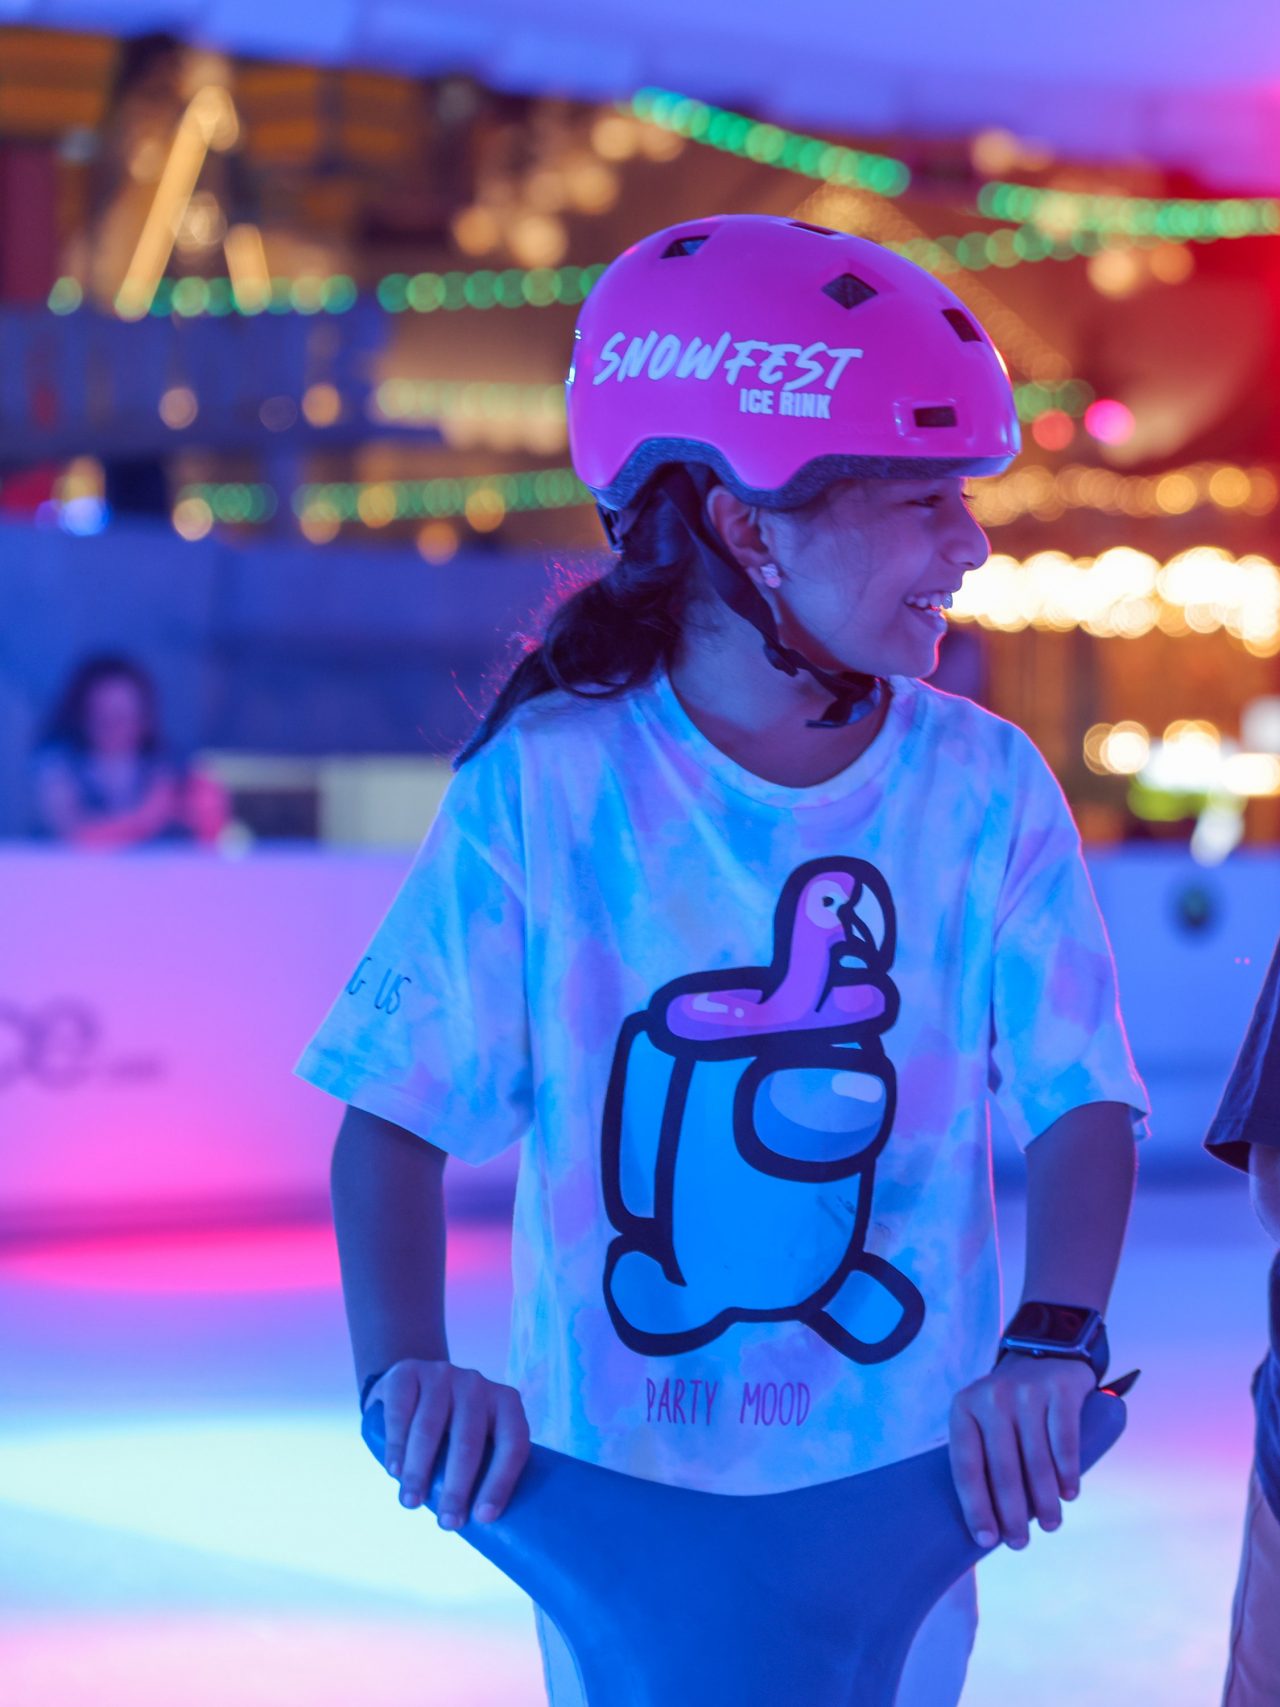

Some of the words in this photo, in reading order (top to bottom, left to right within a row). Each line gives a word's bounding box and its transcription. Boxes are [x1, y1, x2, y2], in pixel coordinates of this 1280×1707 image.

[592, 330, 864, 391] SNOWFEST
[739, 388, 774, 415] ICE
[778, 391, 832, 419] RINK
[374, 967, 412, 1015] US
[646, 1377, 718, 1426] PARTY
[739, 1381, 811, 1427] MOOD
